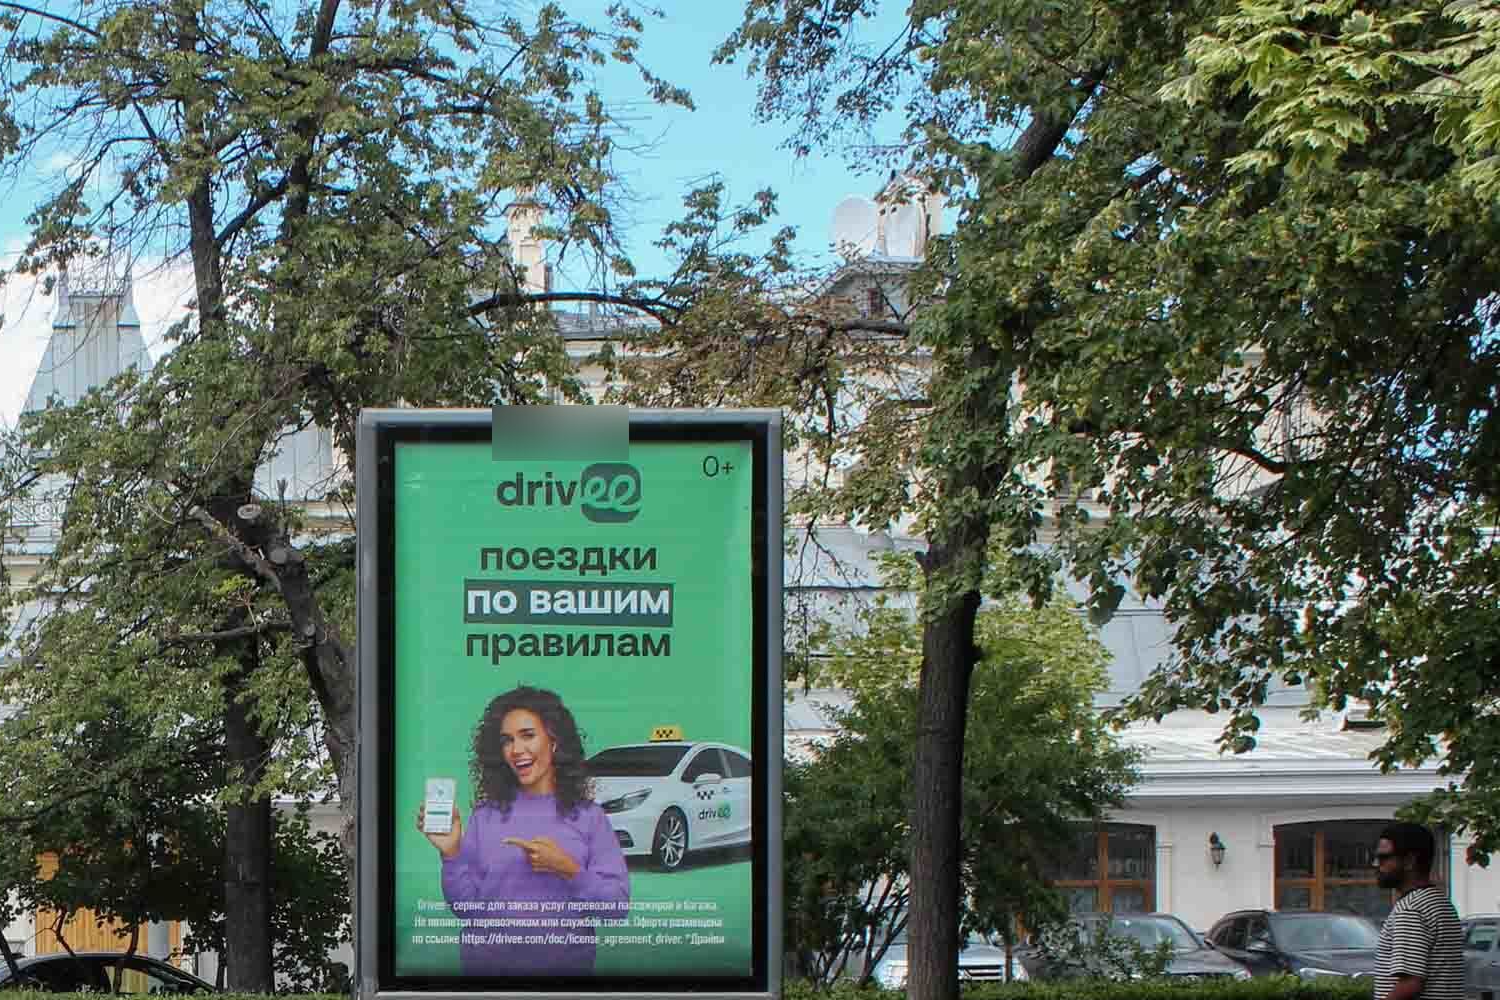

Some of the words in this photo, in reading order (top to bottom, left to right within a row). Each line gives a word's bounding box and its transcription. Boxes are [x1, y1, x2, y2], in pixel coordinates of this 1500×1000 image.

[702, 455, 735, 478] 0+
[496, 468, 642, 518] drivee
[479, 546, 658, 576] поездки
[466, 589, 518, 615] по
[529, 589, 670, 615] вашим
[465, 633, 672, 665] правилам
[453, 901, 484, 913] сервис
[487, 901, 506, 912] для
[507, 901, 539, 911] заказа
[540, 901, 565, 913] услуг
[567, 901, 616, 913] перевозки
[473, 917, 539, 929] перевозчиком
[540, 917, 559, 928] или
[560, 914, 601, 929] службой
[412, 935, 424, 945] по
[425, 935, 460, 945] ссылке
